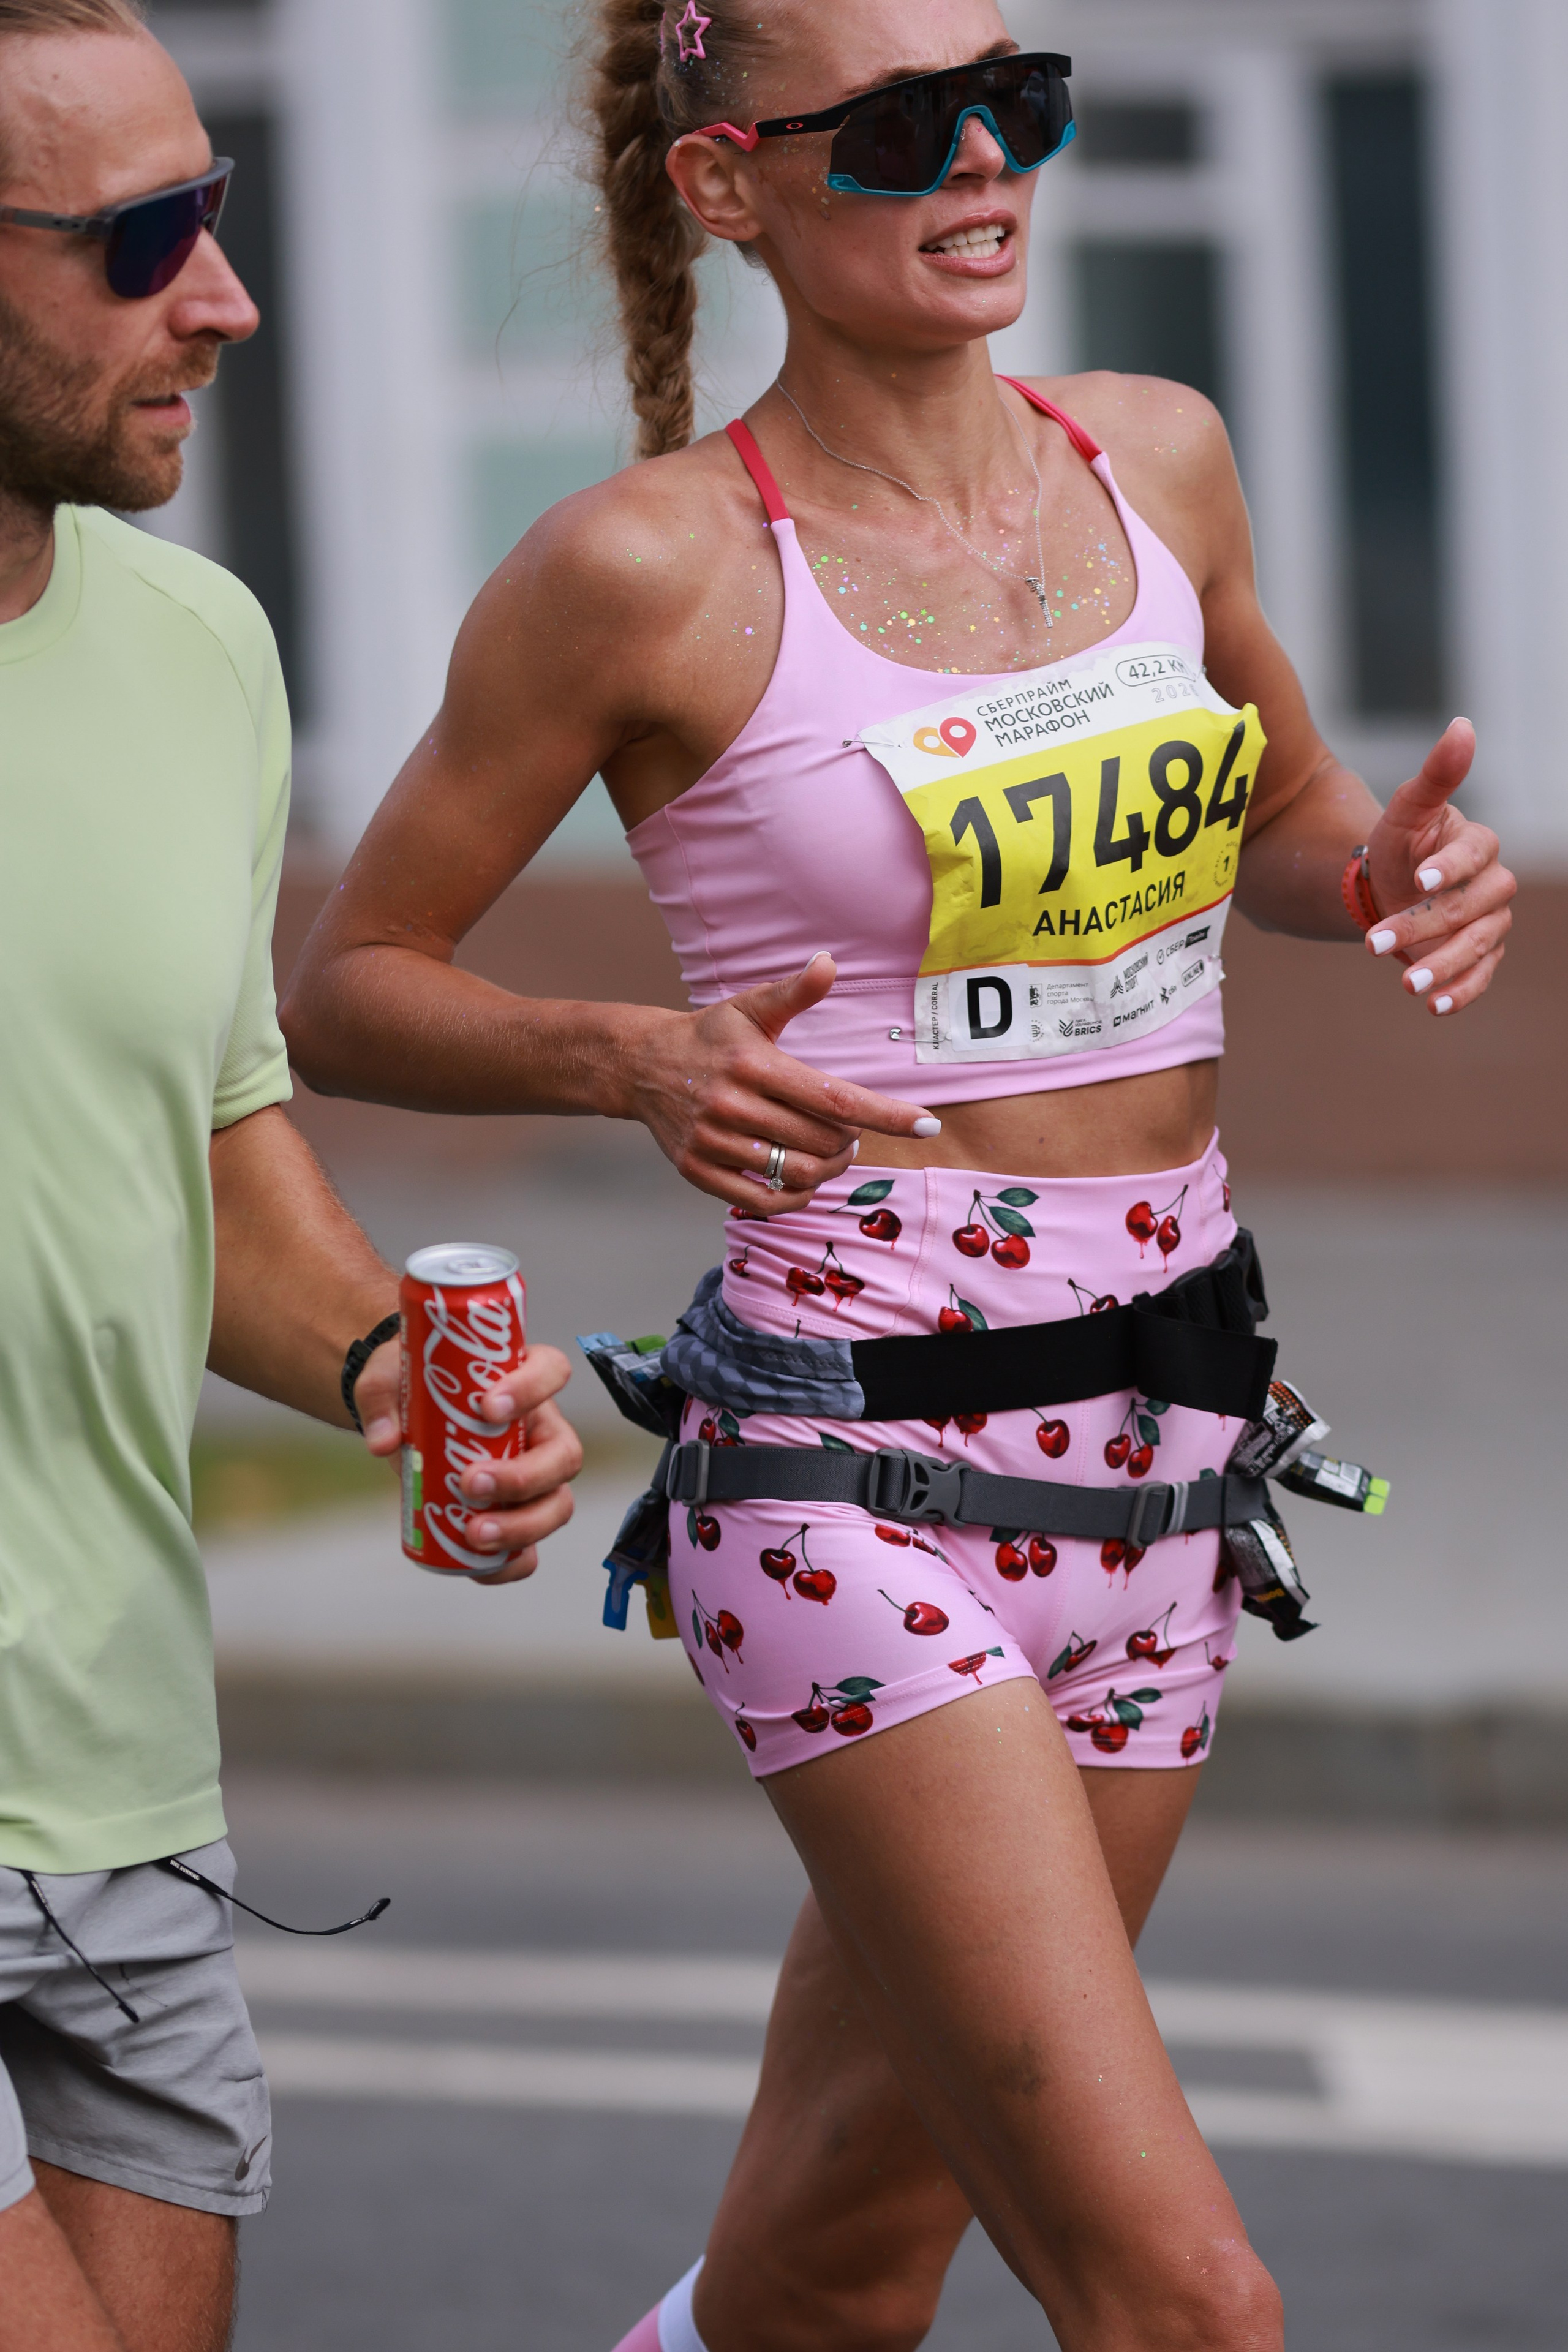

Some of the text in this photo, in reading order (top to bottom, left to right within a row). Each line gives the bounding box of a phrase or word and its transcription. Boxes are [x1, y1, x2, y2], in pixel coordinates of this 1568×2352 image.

[1129, 660, 1165, 678] 42,2
[977, 679, 1072, 716] СБЕРПРАЙМ
[984, 682, 1114, 731] МОСКОВСКИЙ
[994, 710, 1090, 747] МАРАФОН
[950, 720, 1249, 909] 17484
[1033, 870, 1185, 937] АНАСТАСИЯ
[1166, 940, 1185, 957] СБЕР
[967, 976, 1012, 1039] D
[1074, 1025, 1102, 1036] BRICS
